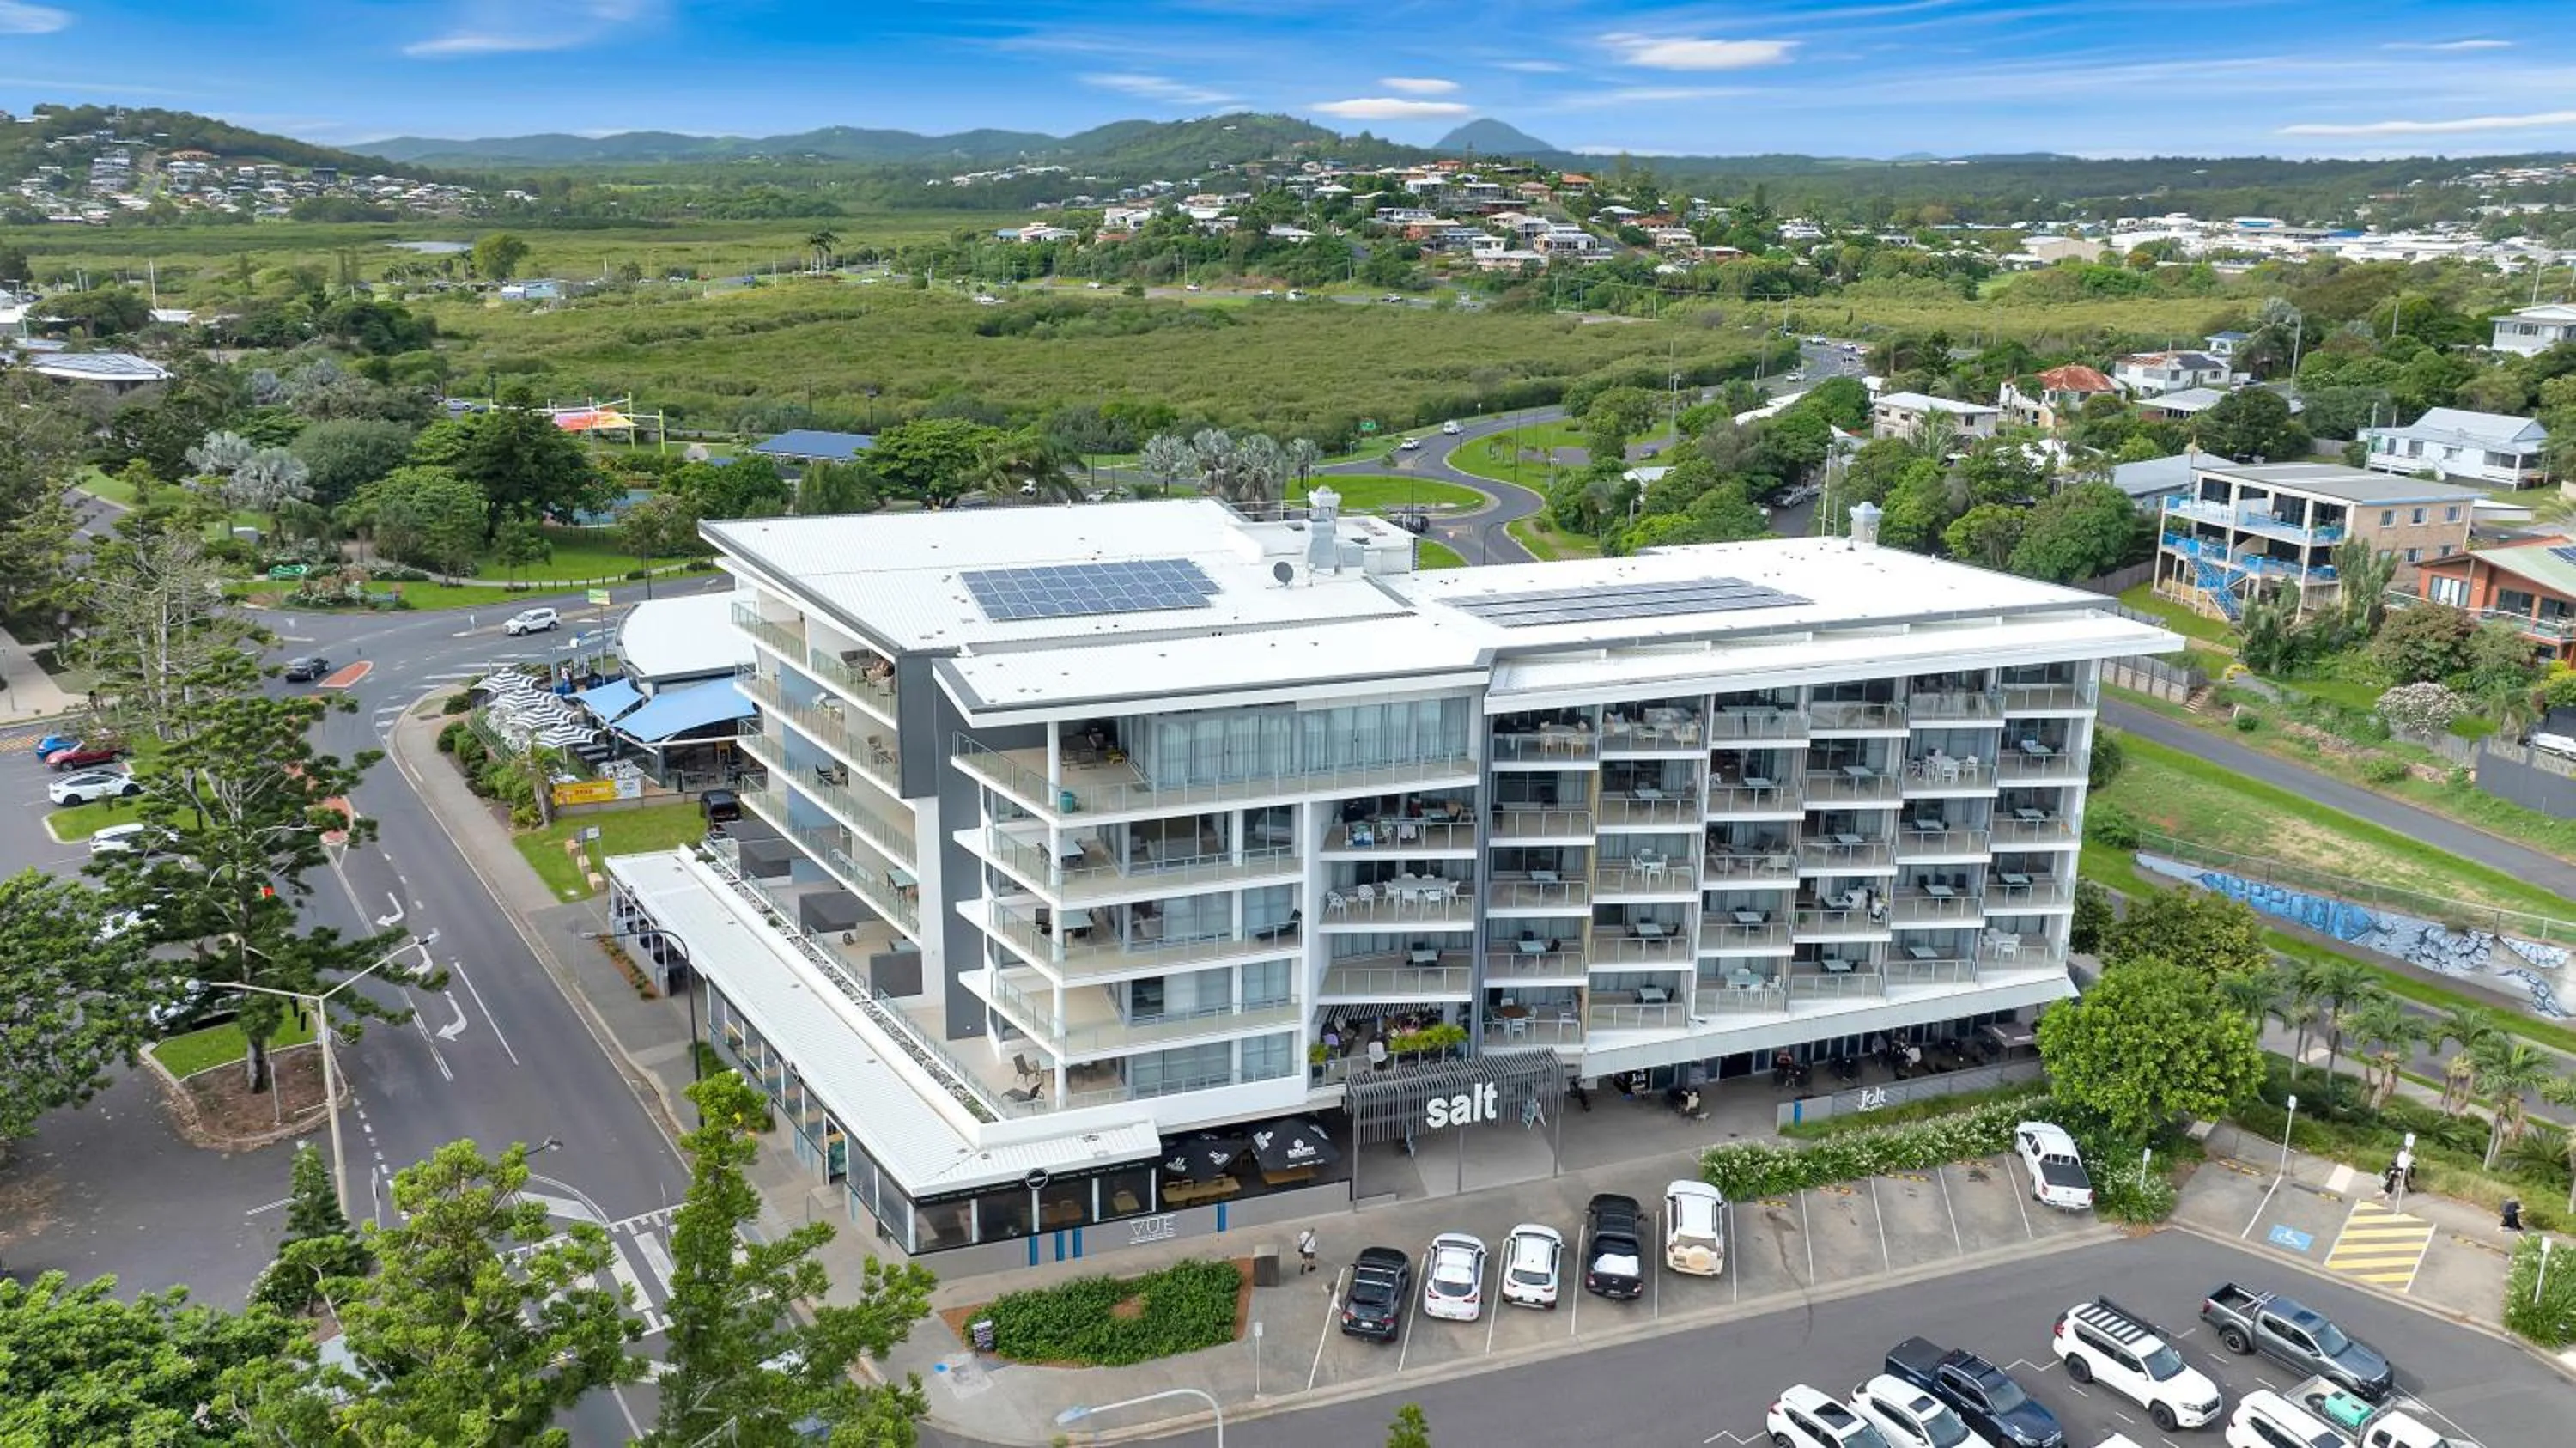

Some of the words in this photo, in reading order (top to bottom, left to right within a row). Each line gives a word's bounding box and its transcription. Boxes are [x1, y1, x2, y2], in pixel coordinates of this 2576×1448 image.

[1426, 1081, 1498, 1129] salt
[1858, 1086, 1886, 1108] Jolt
[1130, 1214, 1176, 1235] VUE
